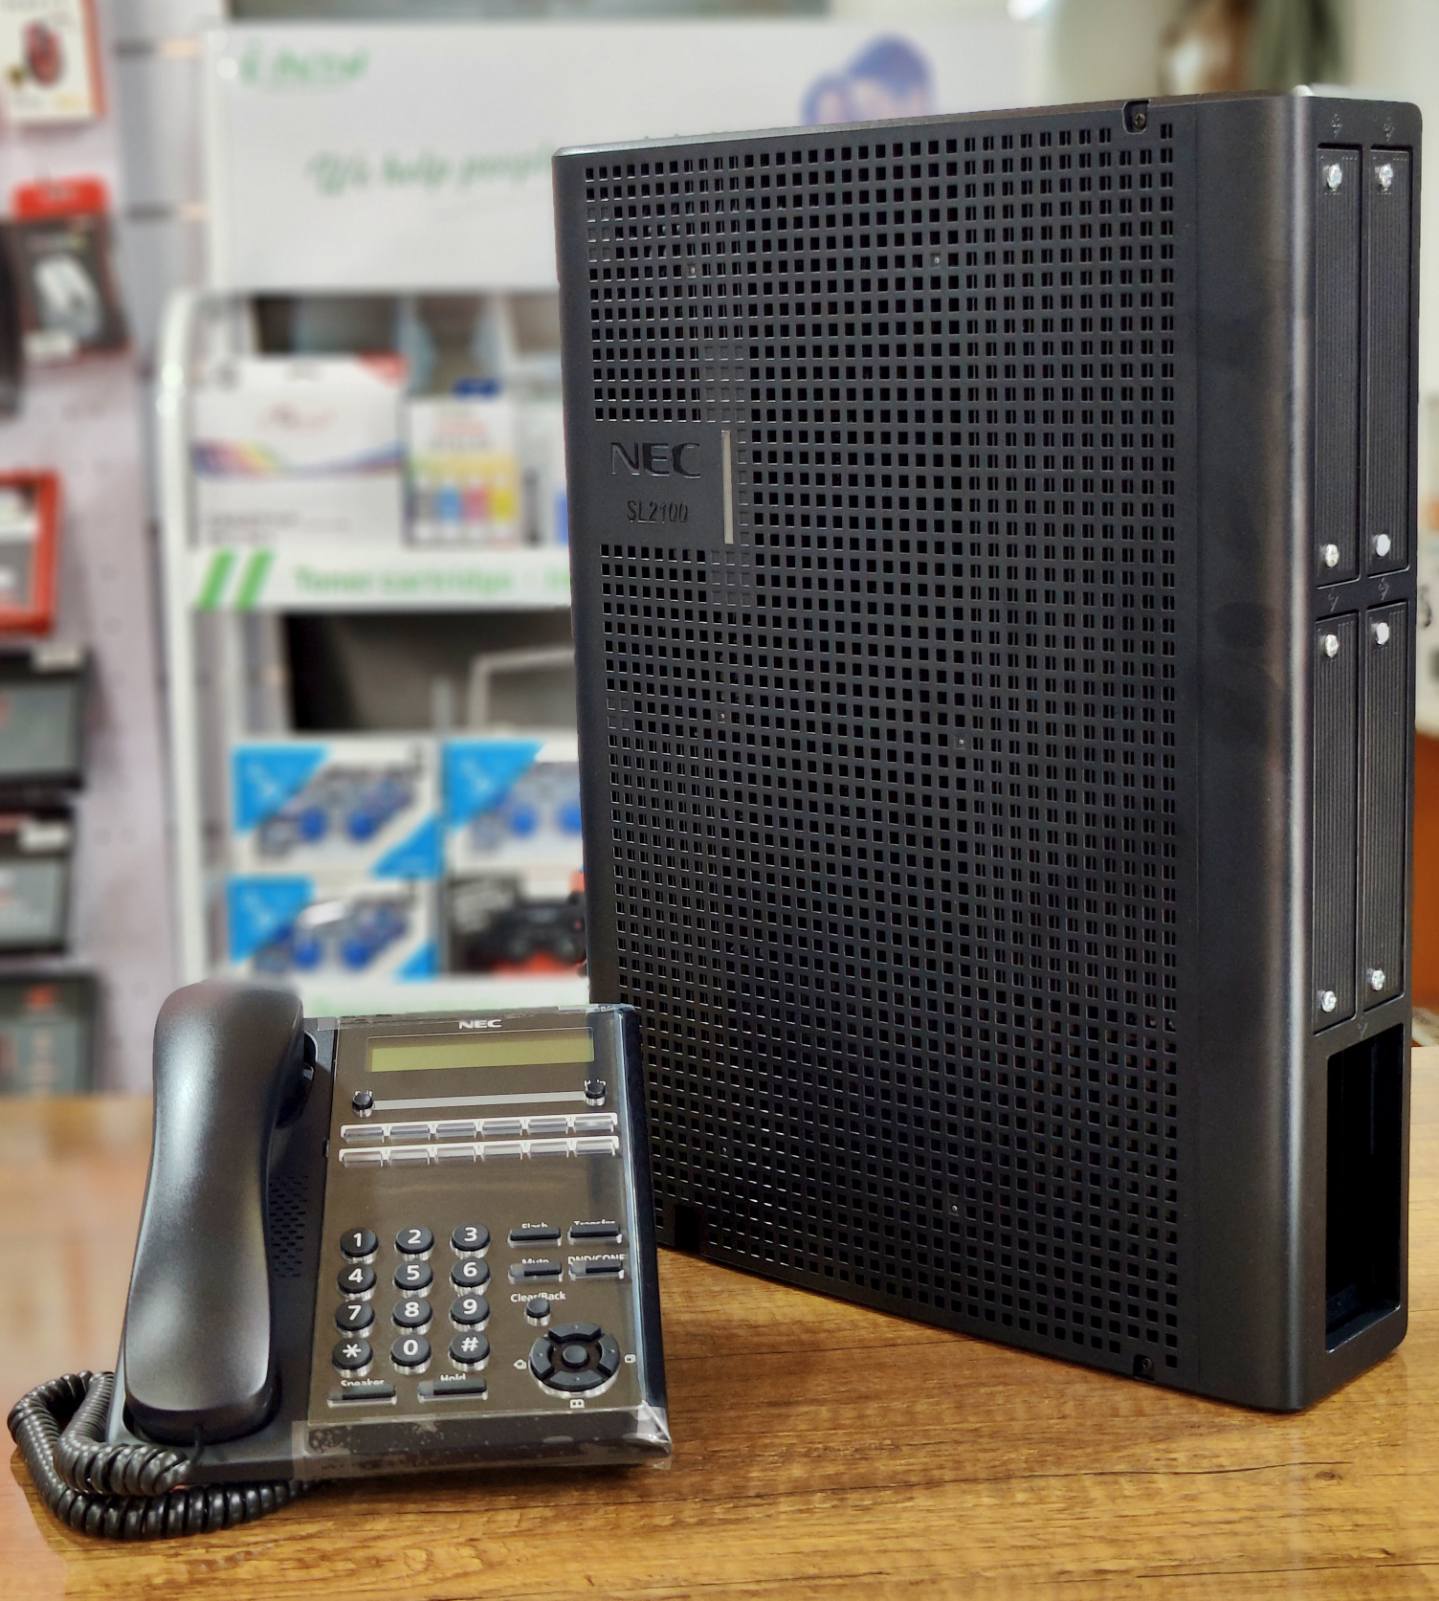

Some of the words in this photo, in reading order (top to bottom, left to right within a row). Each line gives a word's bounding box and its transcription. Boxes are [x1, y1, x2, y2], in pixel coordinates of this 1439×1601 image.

[610, 442, 701, 478] NEC
[627, 500, 688, 523] SL2100
[458, 1019, 502, 1030] NEC
[353, 1232, 362, 1247] 1
[407, 1229, 422, 1244] 2
[464, 1227, 478, 1242] 3
[348, 1268, 363, 1283] 4
[406, 1265, 420, 1280] 5
[463, 1262, 478, 1277] 6
[347, 1305, 362, 1320] 7
[404, 1301, 420, 1317] 8
[462, 1299, 478, 1315] 9
[403, 1339, 419, 1355] 0
